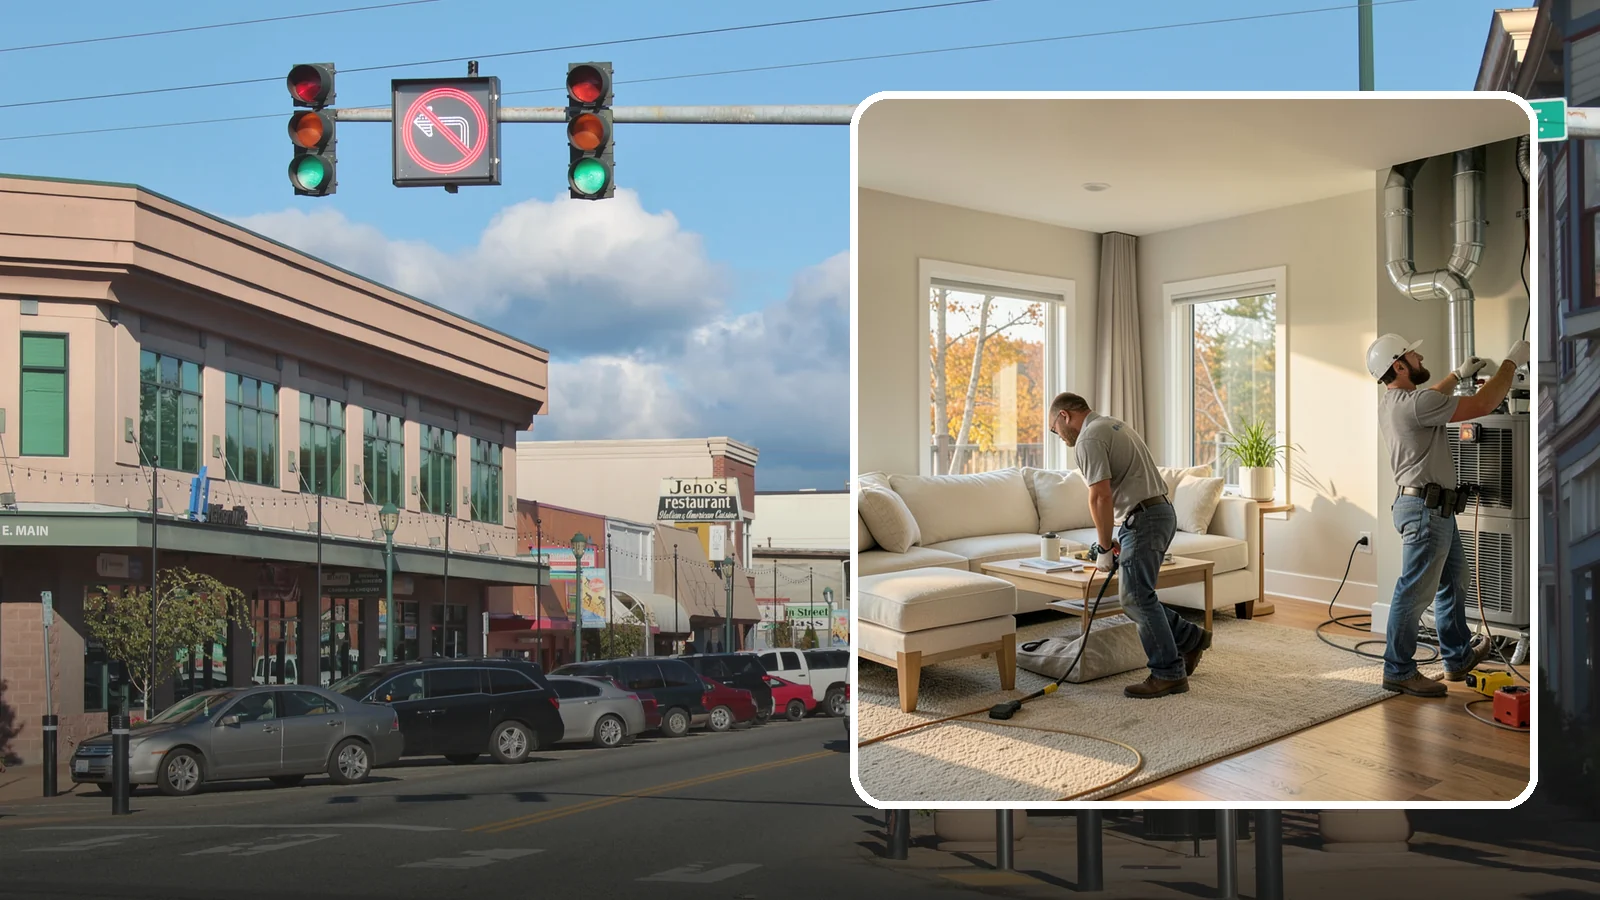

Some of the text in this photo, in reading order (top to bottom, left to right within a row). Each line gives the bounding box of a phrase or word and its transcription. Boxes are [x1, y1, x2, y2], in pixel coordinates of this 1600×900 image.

[669, 480, 727, 494] Jeno's
[665, 496, 731, 509] restaurant
[686, 510, 714, 519] American
[715, 509, 737, 519] Cuisine
[2, 525, 49, 537] E. MAIN
[797, 608, 829, 617] Street
